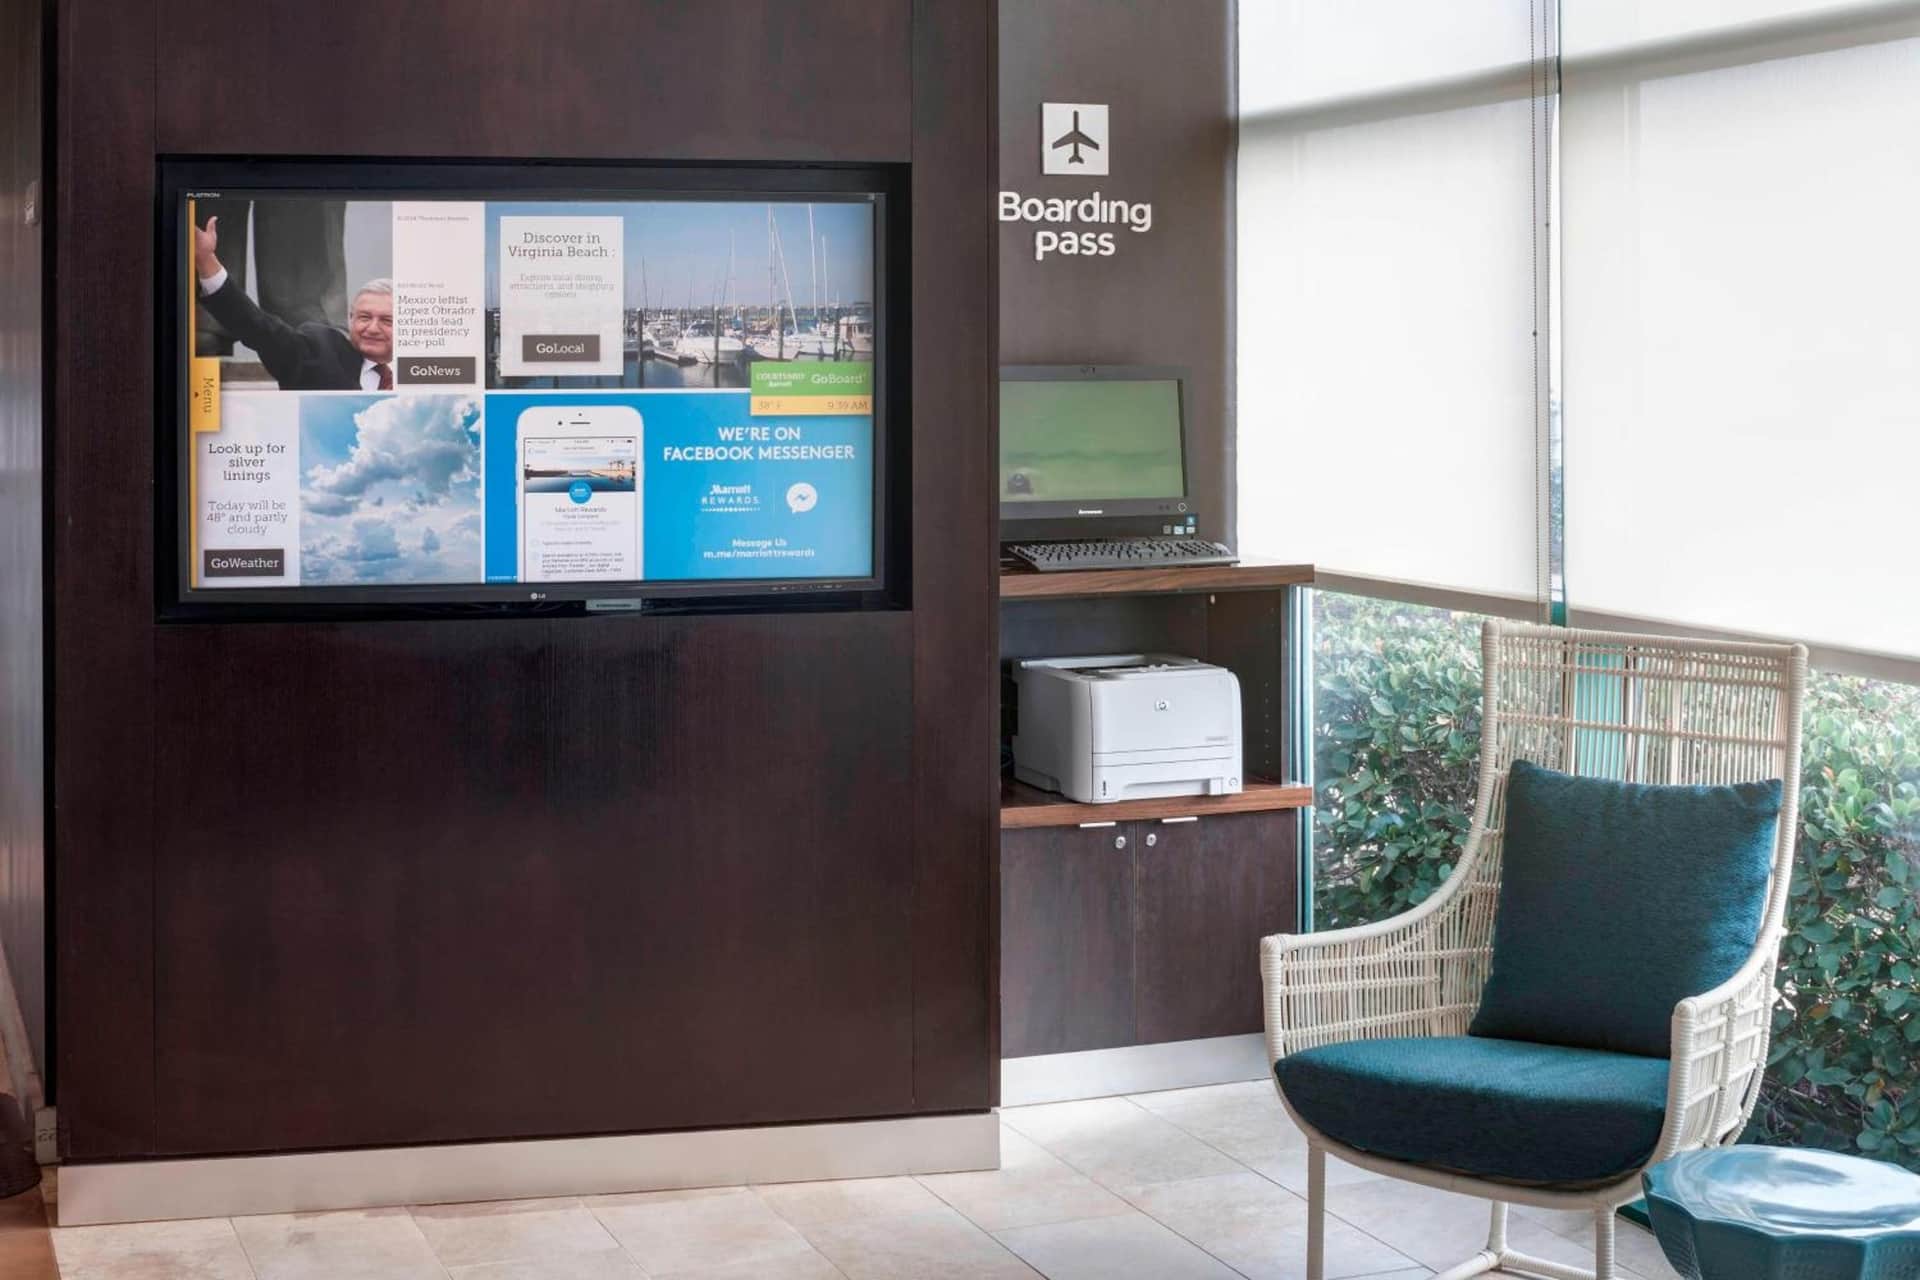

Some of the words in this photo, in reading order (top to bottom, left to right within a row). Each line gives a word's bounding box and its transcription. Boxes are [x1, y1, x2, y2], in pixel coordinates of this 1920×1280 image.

[998, 191, 1152, 232] Boarding
[523, 231, 583, 245] Discover
[587, 231, 601, 244] in
[508, 245, 563, 260] Virginia
[567, 245, 608, 257] Beach
[1035, 231, 1116, 261] pass
[397, 295, 437, 305] Mexico
[438, 294, 469, 305] leftist
[397, 305, 430, 318] Lopez
[432, 305, 476, 316] Obrador
[397, 316, 439, 327] extends
[441, 316, 464, 327] lead
[397, 326, 409, 337] in
[411, 326, 470, 340] presidency
[535, 342, 585, 355] GoLocal
[410, 364, 462, 377] GoNews
[202, 377, 215, 414] Menu
[718, 426, 769, 442] WE'RE
[775, 426, 801, 442] ON
[208, 443, 242, 455] Look
[245, 445, 264, 458] up
[266, 443, 286, 455] for
[663, 445, 754, 462] FACEBOOK
[758, 444, 856, 461] MESSENGER
[228, 456, 265, 468] silver
[222, 469, 272, 483] linings
[207, 500, 246, 514] Today
[248, 500, 270, 512] will
[272, 500, 287, 511] be
[701, 496, 761, 505] REWARDS
[228, 512, 252, 523] and
[254, 512, 289, 527] partly
[226, 524, 268, 537] cloudy
[210, 557, 280, 570] GoWeather
